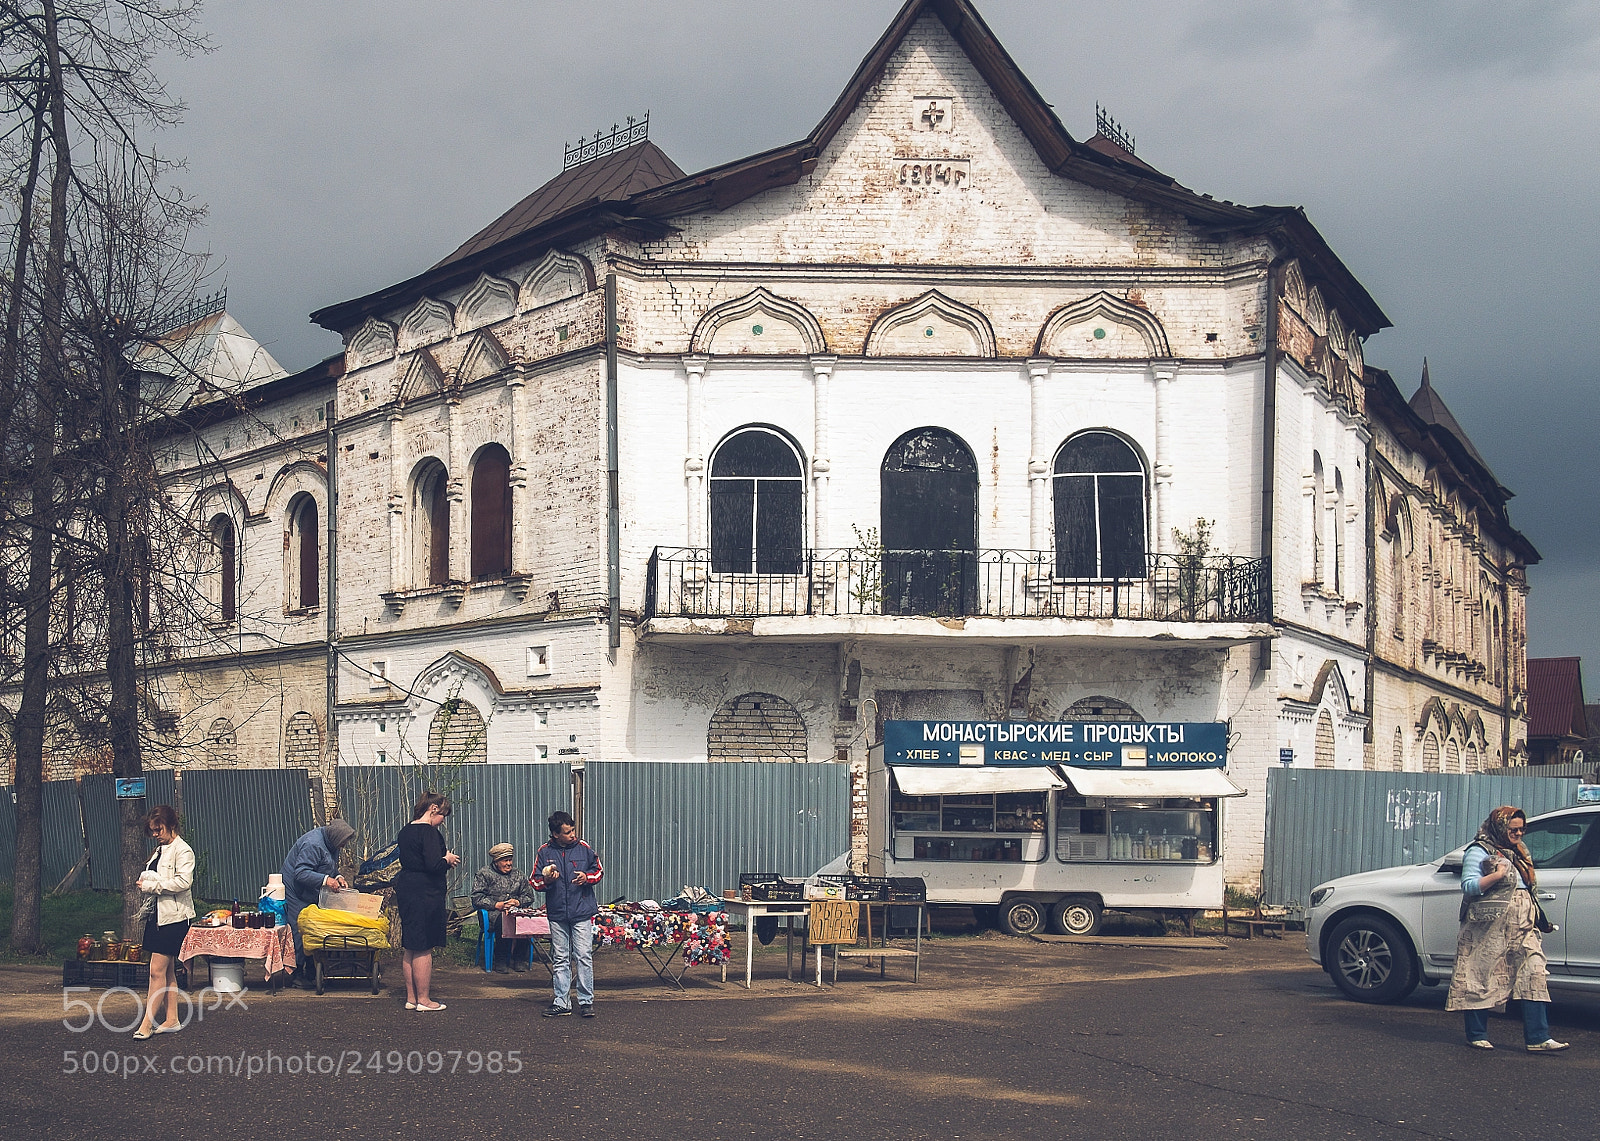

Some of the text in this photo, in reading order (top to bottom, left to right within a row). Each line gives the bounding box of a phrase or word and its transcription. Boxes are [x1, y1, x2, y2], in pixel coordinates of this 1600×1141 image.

[923, 722, 1185, 744] МОНАСТЫРСКИЕ ПРОДУКТЫ
[906, 749, 1217, 763] ХЛЕБ КВАС МЕД СЫР МОЛОКО
[815, 902, 854, 920] РЫБА
